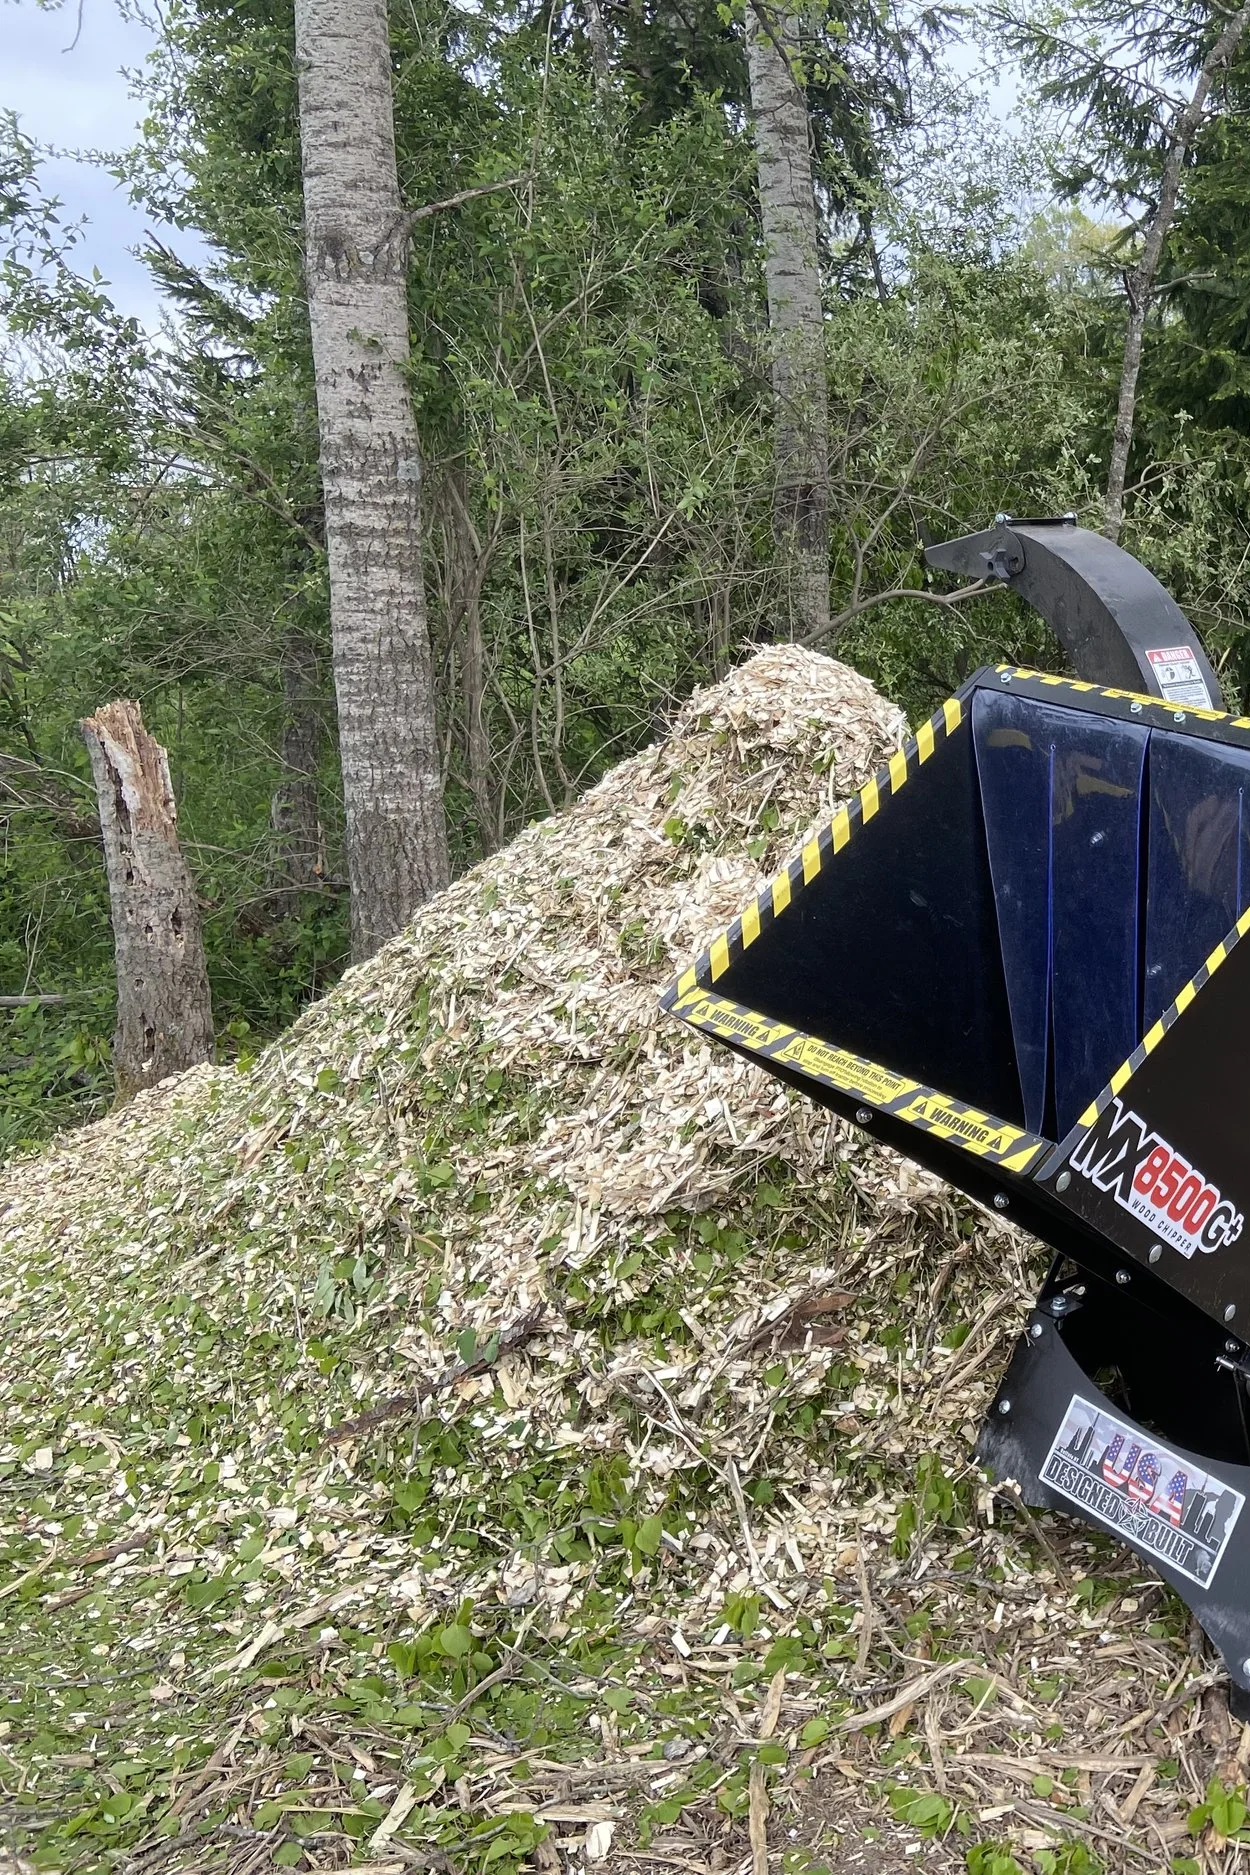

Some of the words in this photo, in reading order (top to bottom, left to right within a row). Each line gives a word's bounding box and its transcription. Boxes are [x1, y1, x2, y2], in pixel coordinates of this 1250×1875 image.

[709, 1009, 760, 1037] WARNING
[807, 1045, 816, 1053] DO
[816, 1048, 830, 1058] NOT
[828, 1053, 848, 1067] REACH
[846, 1061, 870, 1077] BEYOND
[869, 1070, 885, 1082] THIS
[882, 1077, 901, 1091] POINT
[929, 1108, 989, 1143] WARNING
[1131, 1199, 1156, 1222] WOOD
[1157, 1220, 1192, 1251] CHIPPER
[1046, 1454, 1121, 1519] DESIGNED
[1101, 1433, 1188, 1528] USA
[1142, 1518, 1194, 1566] BUILT
